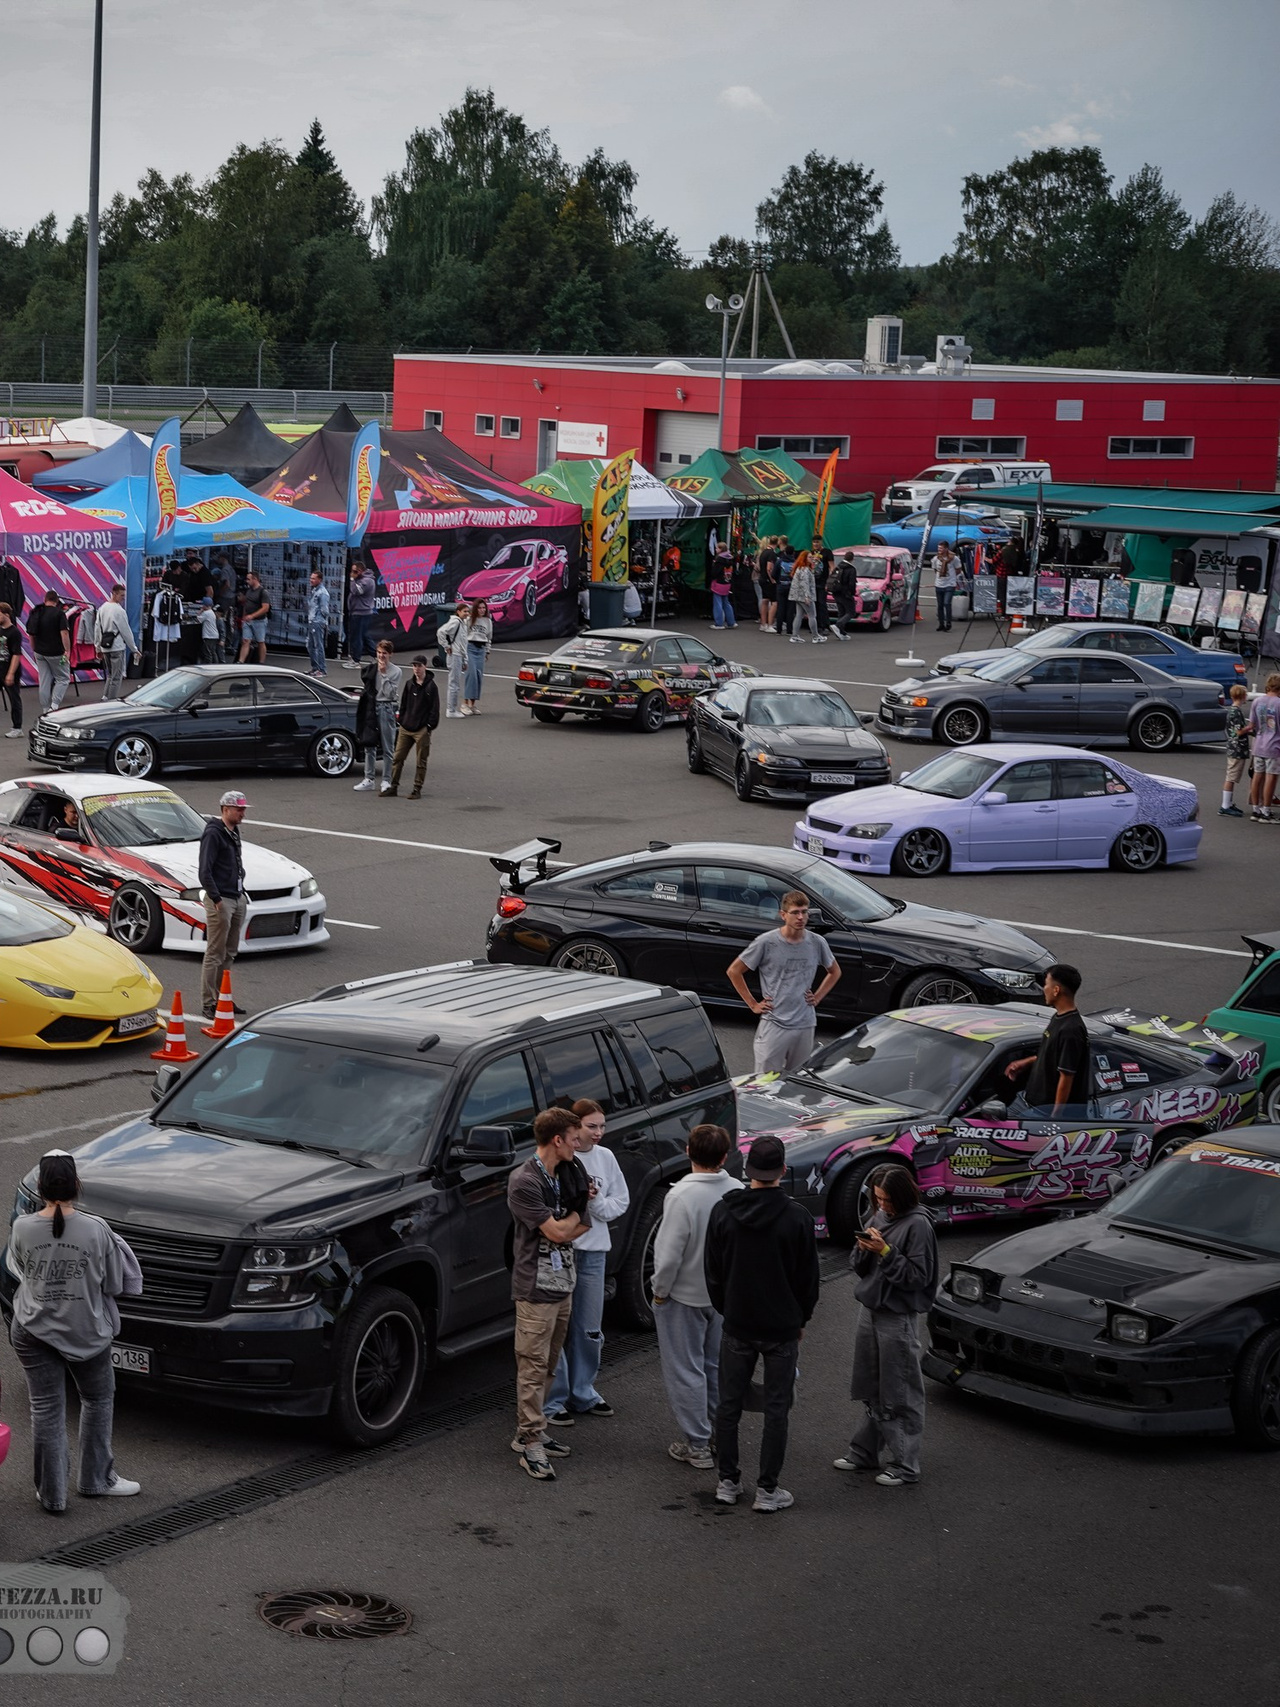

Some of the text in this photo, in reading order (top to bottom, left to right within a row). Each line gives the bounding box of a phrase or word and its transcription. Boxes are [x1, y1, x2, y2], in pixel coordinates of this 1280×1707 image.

[1010, 470, 1045, 479] EXV
[10, 500, 67, 518] RDS
[397, 510, 433, 528] ЯПОНА
[466, 509, 506, 527] TUNING
[508, 509, 538, 525] SHOP
[23, 531, 113, 553] RDS-SHOP.RU
[390, 580, 424, 596] ДЛЯ ТЕБЯ
[401, 592, 446, 607] АВТОМОБИЛЯ
[1140, 1085, 1220, 1126] NEED
[954, 1126, 1028, 1141] RACE CLUB
[953, 1147, 989, 1157] AUTO
[1029, 1130, 1122, 1170] ALL
[949, 1155, 993, 1168] TUNING
[952, 1167, 987, 1177] SHOW
[952, 1185, 1007, 1198] BULLDOZER
[25, 1258, 89, 1281] GAMES
[123, 1350, 145, 1366] 138
